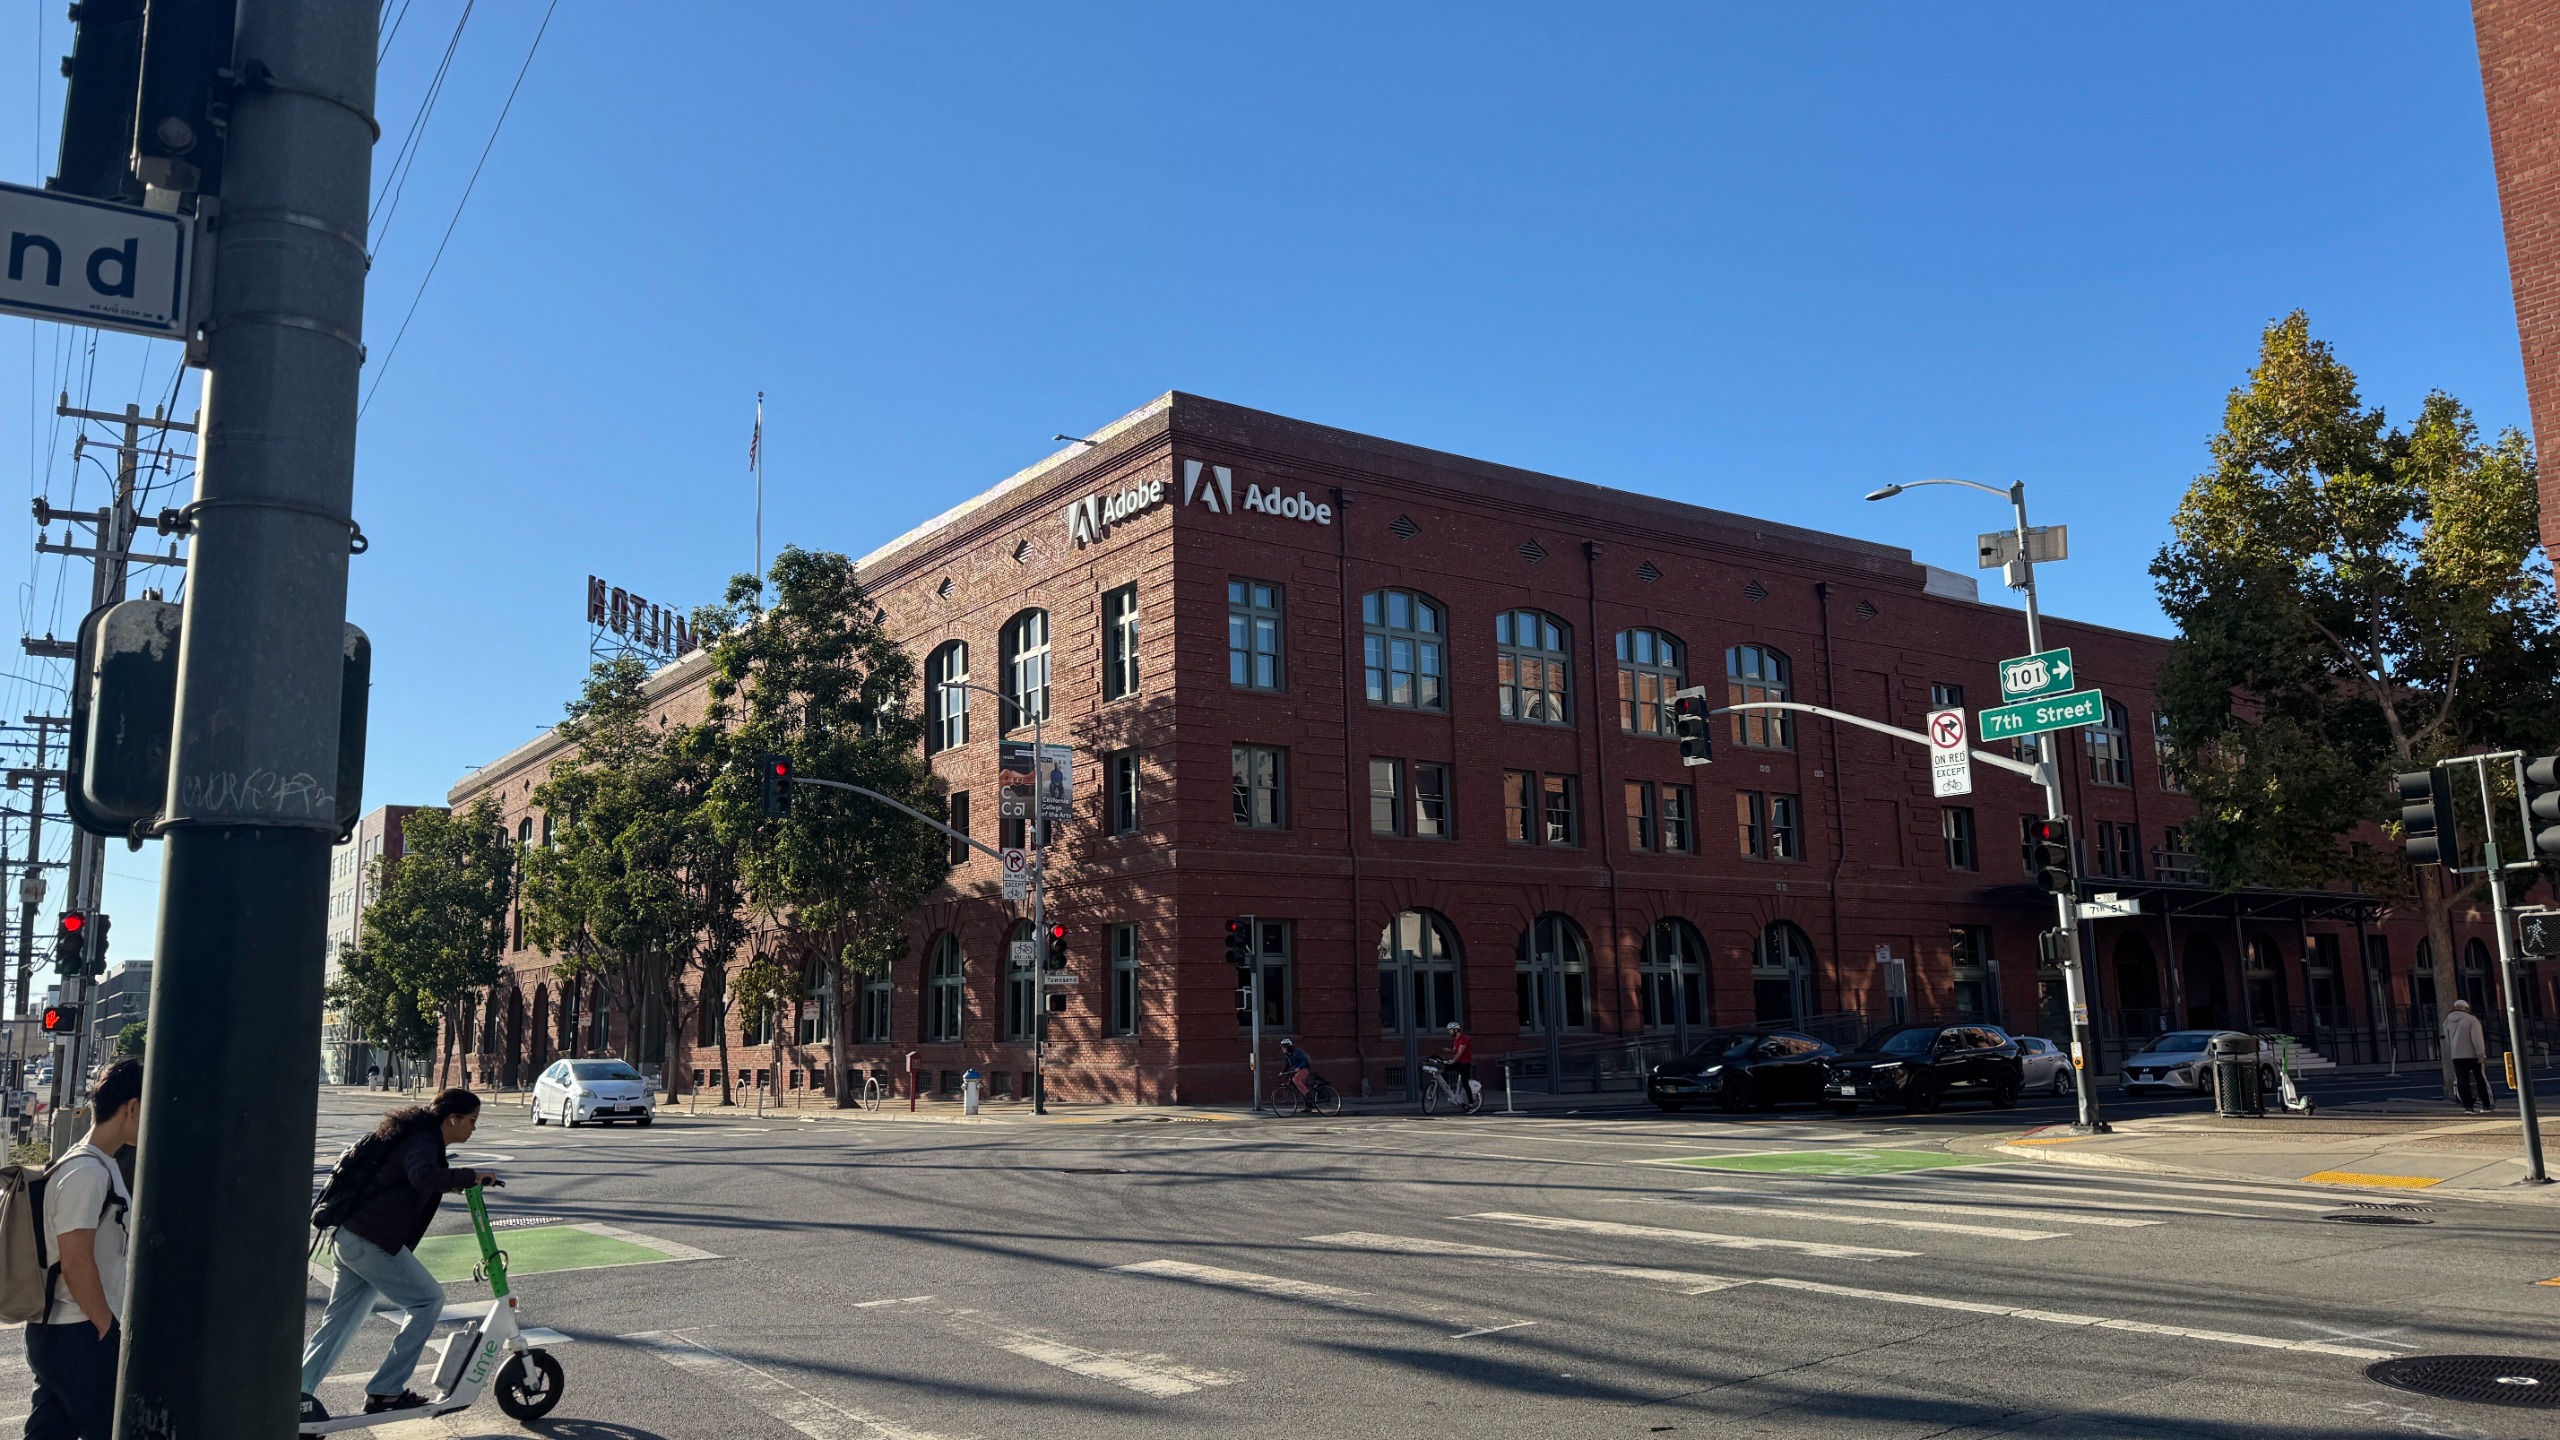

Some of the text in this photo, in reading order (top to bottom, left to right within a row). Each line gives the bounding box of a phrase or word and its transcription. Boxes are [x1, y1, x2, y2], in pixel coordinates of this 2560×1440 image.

[8, 231, 138, 298] nd
[1102, 479, 1165, 526] Adobe
[1243, 483, 1332, 525] Adobe
[2012, 667, 2041, 687] 101
[1990, 699, 2093, 732] 7th Street
[1934, 750, 1966, 765] ON RED
[1936, 766, 1966, 778] EXCEPT
[1042, 796, 1070, 804] California
[1042, 804, 1062, 812] College
[2111, 904, 2122, 913] St
